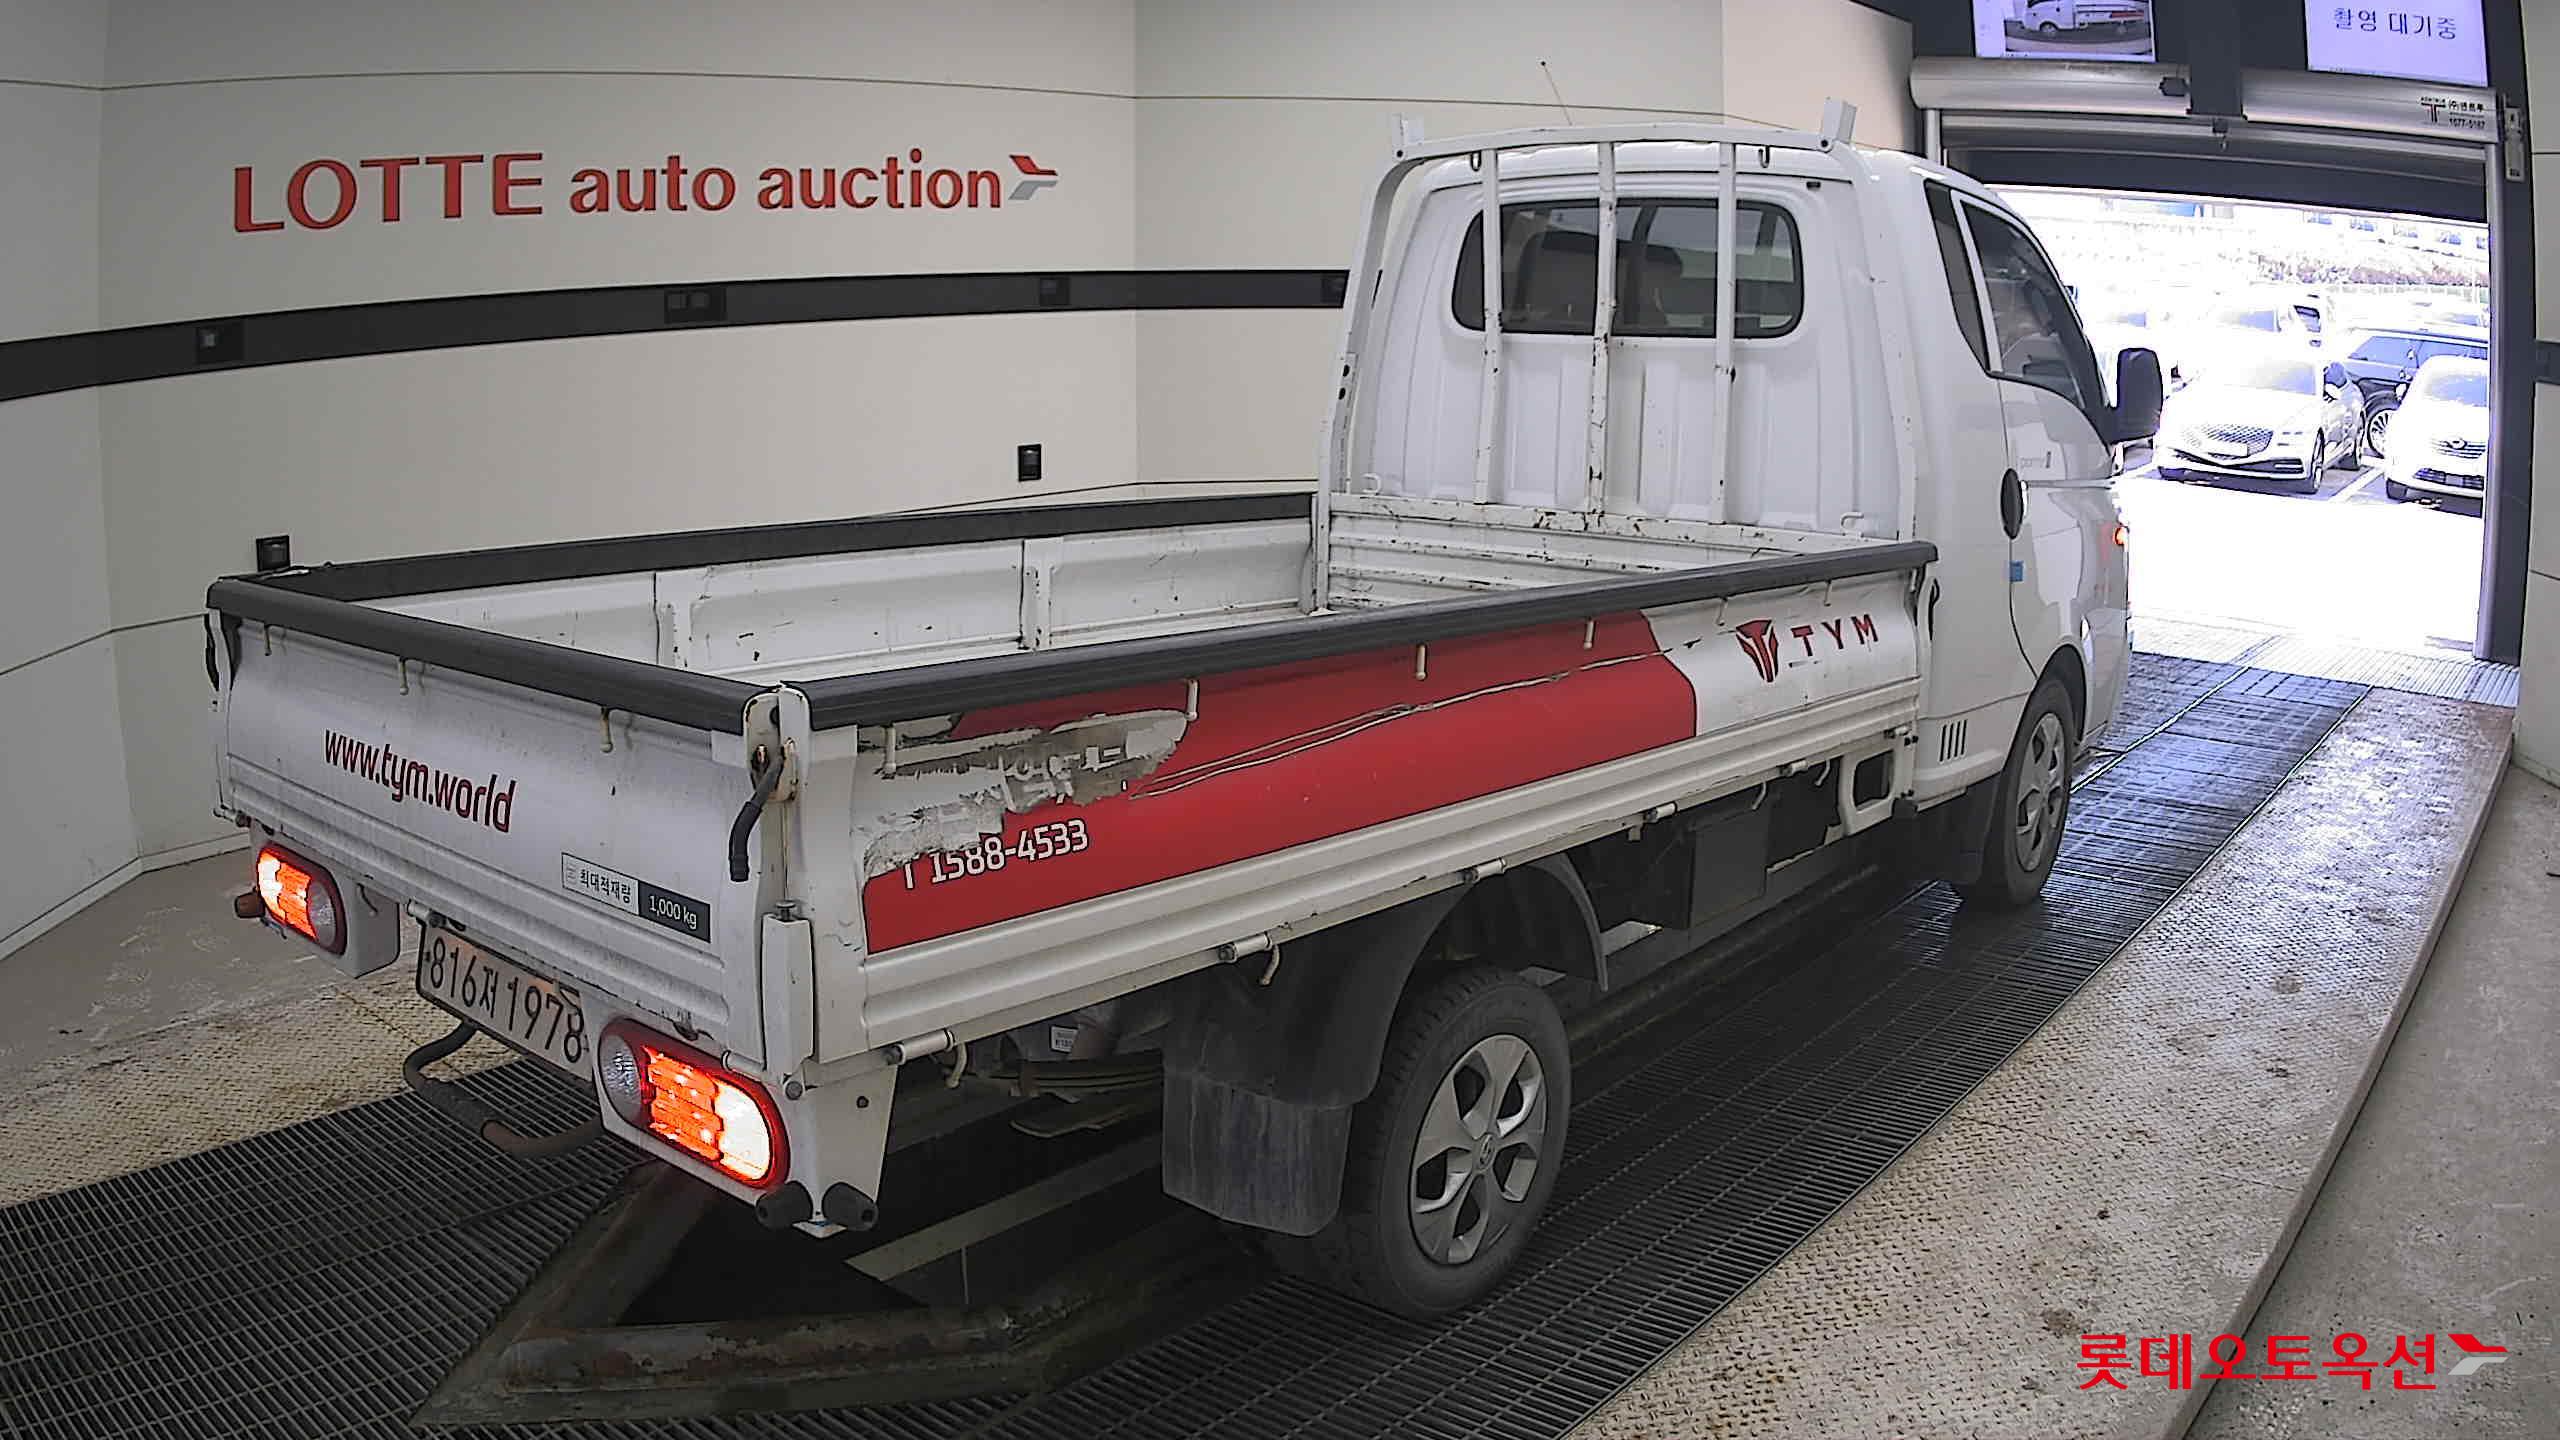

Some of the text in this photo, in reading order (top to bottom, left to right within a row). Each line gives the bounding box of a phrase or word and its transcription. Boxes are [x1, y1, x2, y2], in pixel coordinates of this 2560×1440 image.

[2334, 7, 2457, 40] 촬영 대기중
[234, 147, 1003, 233] LOTTE auto auction
[1790, 613, 1879, 657] TYM
[324, 728, 518, 833] www.tym.world
[929, 818, 1090, 884] 1588-4533
[580, 868, 698, 931] 최대적재량 1,000 kg
[430, 936, 585, 1064] 816저 1978
